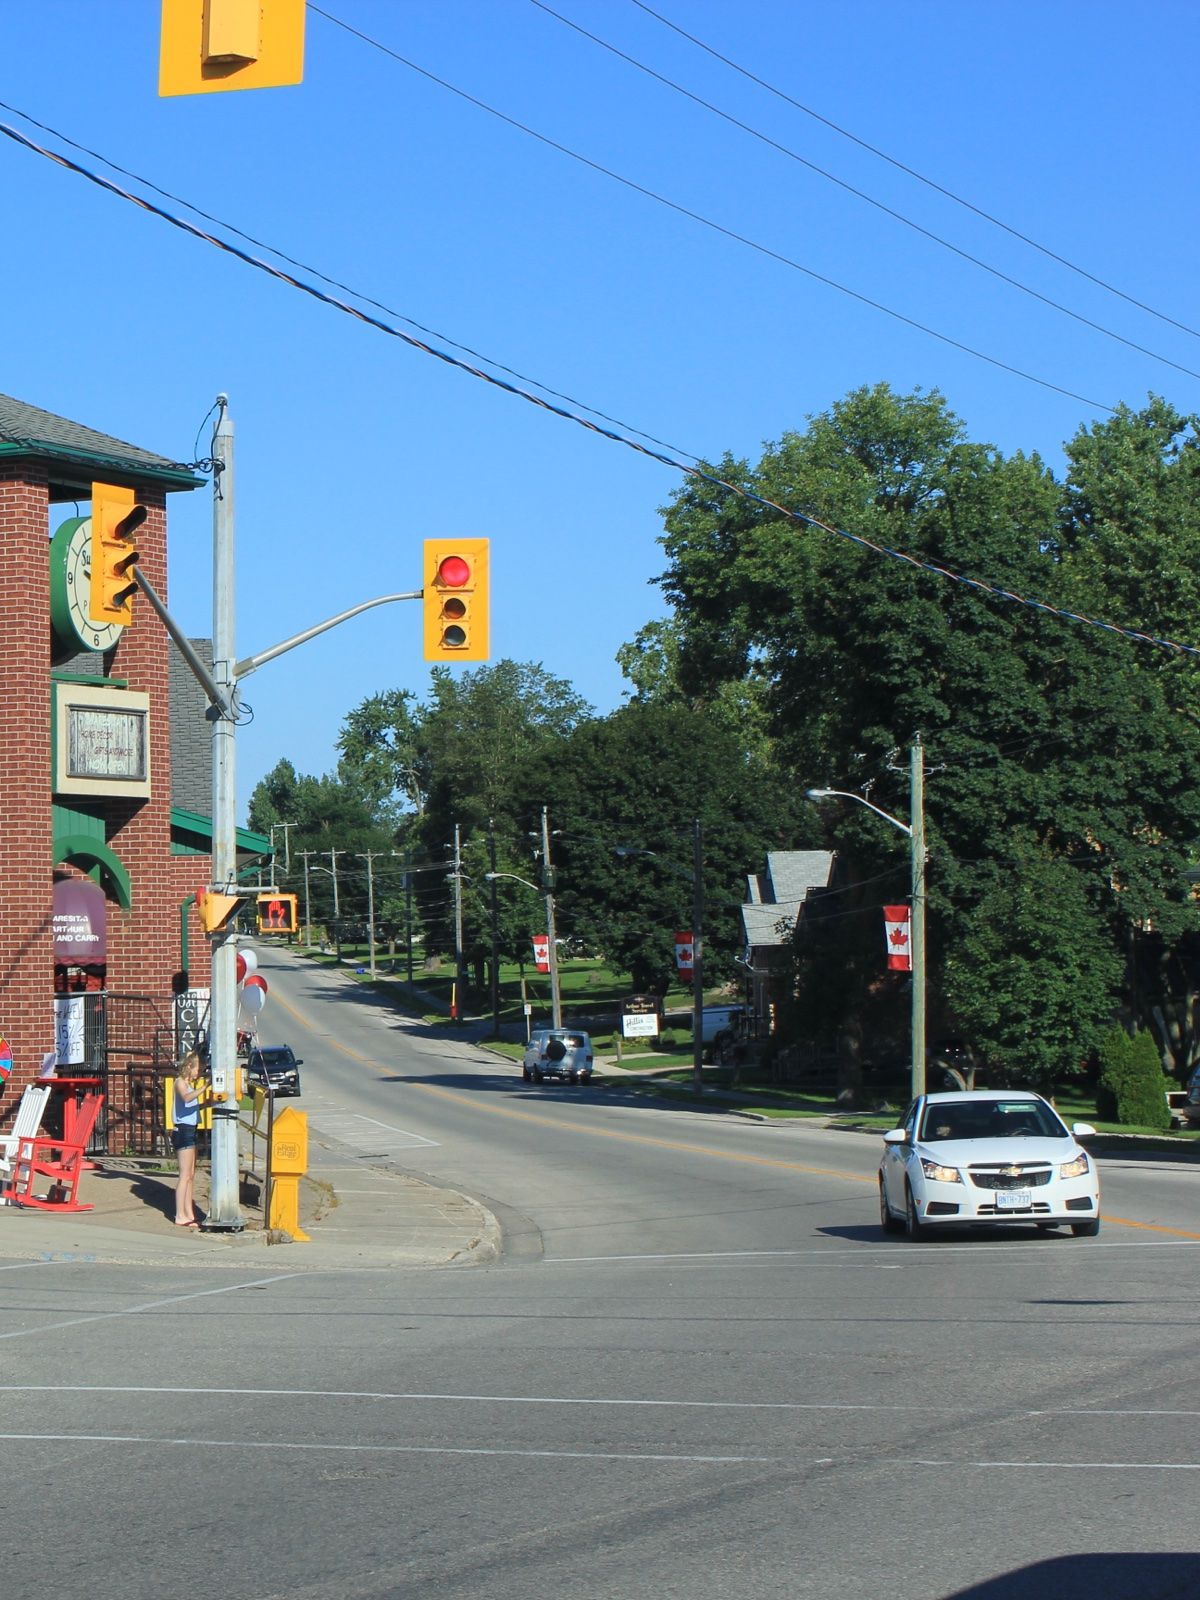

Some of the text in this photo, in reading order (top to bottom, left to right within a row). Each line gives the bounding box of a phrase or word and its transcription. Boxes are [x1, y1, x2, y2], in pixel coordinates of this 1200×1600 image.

[67, 572, 74, 585] 9
[93, 634, 100, 647] 6
[56, 934, 100, 942] AND CARRY
